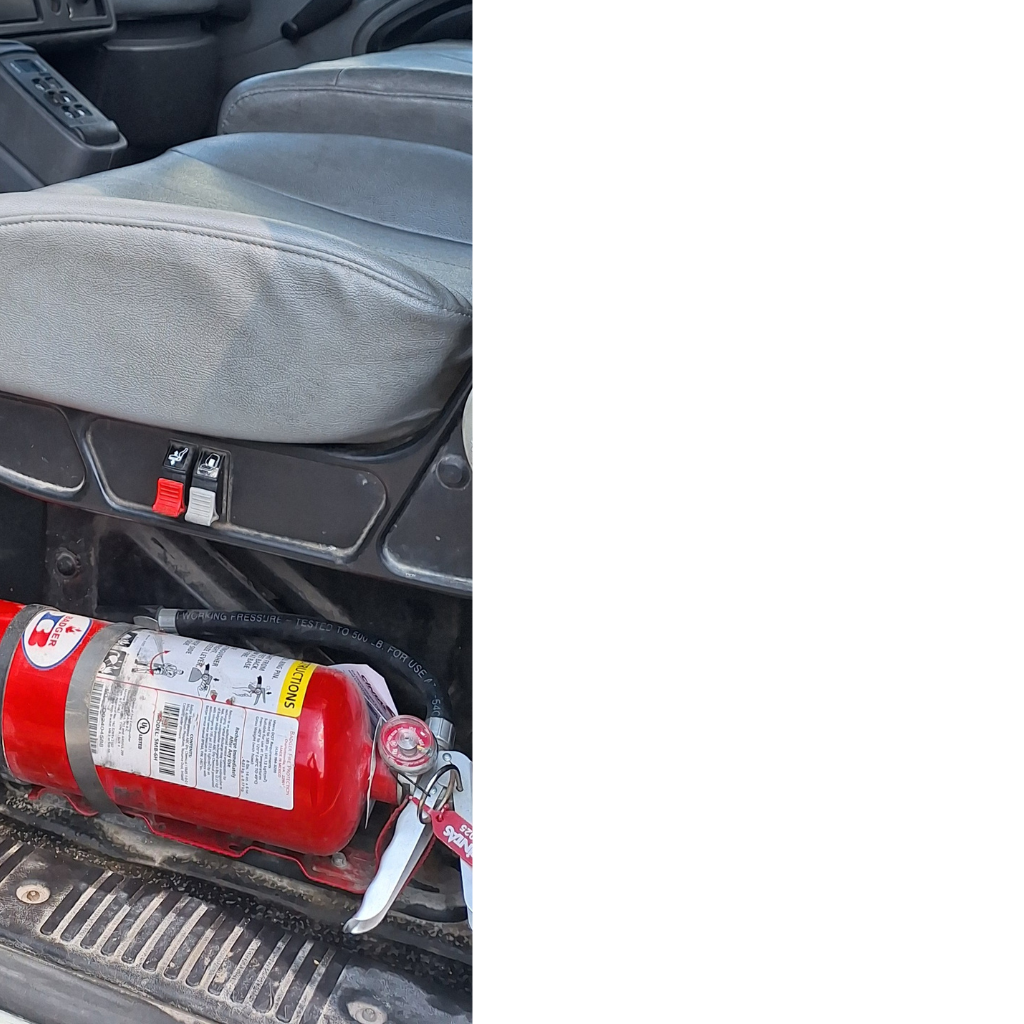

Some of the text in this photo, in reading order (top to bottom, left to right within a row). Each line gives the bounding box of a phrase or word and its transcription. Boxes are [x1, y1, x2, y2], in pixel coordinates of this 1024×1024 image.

[336, 626, 351, 637] TO
[371, 638, 386, 650] B.
[387, 645, 410, 664] FOR
[407, 659, 428, 679] USE
